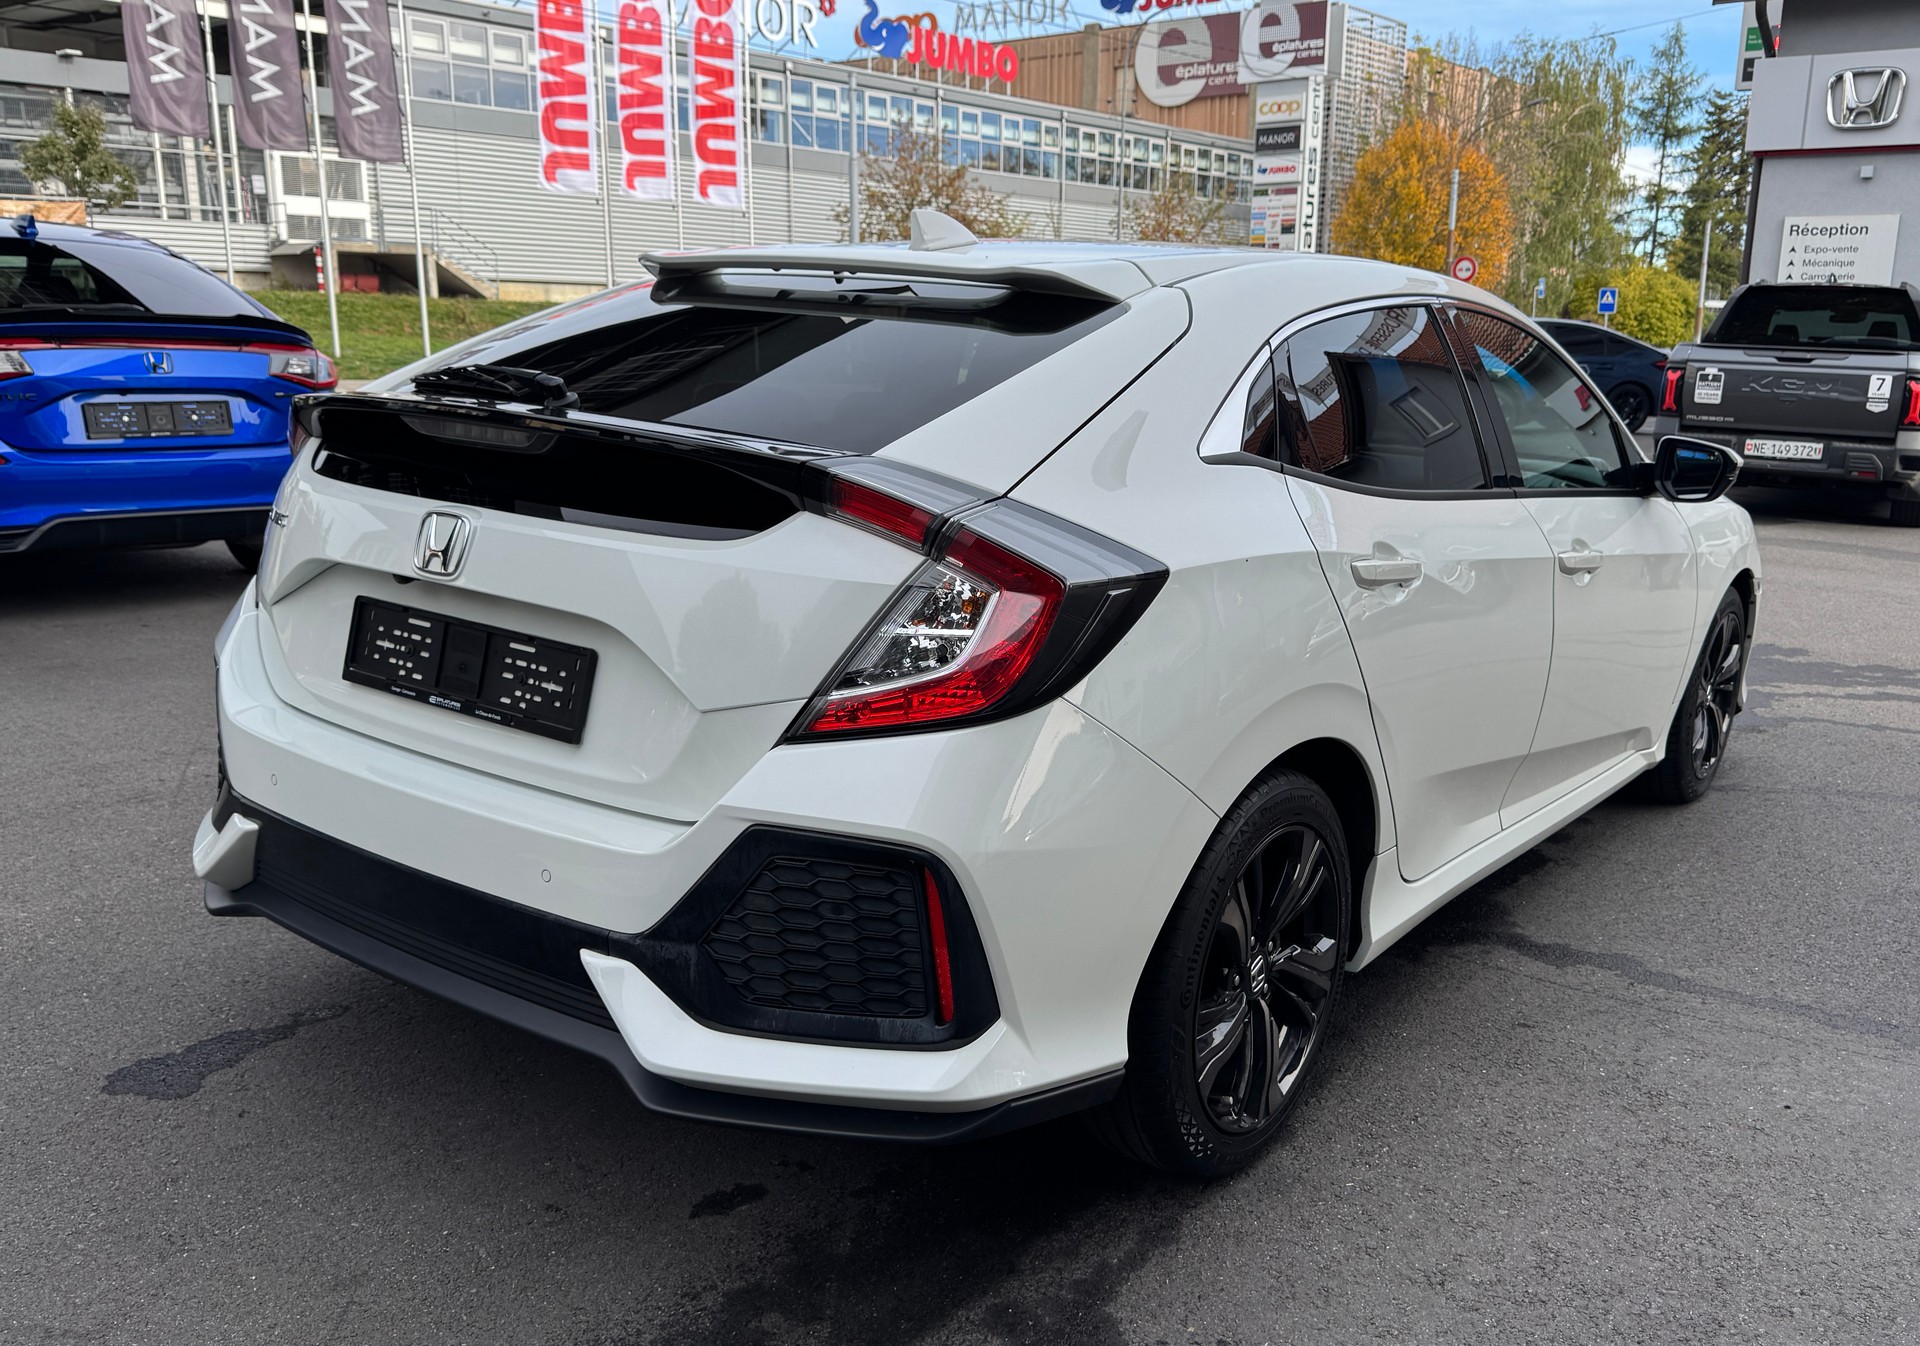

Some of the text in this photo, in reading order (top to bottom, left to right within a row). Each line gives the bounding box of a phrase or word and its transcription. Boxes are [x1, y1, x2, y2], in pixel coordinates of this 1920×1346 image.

[1272, 38, 1325, 53] éplatures
[906, 25, 1019, 82] JUMBO
[1297, 49, 1324, 59] centre
[1208, 74, 1238, 86] centr
[1259, 99, 1300, 117] coop
[1258, 132, 1296, 146] MANOR
[1268, 164, 1296, 176] JUMBO
[1789, 222, 1869, 239] Réception
[1804, 245, 1859, 255] Expo-vente
[1802, 259, 1855, 269] Mécanique
[1800, 272, 1855, 281] Carroerie
[1876, 377, 1886, 392] 7
[0, 392, 38, 402] VIC
